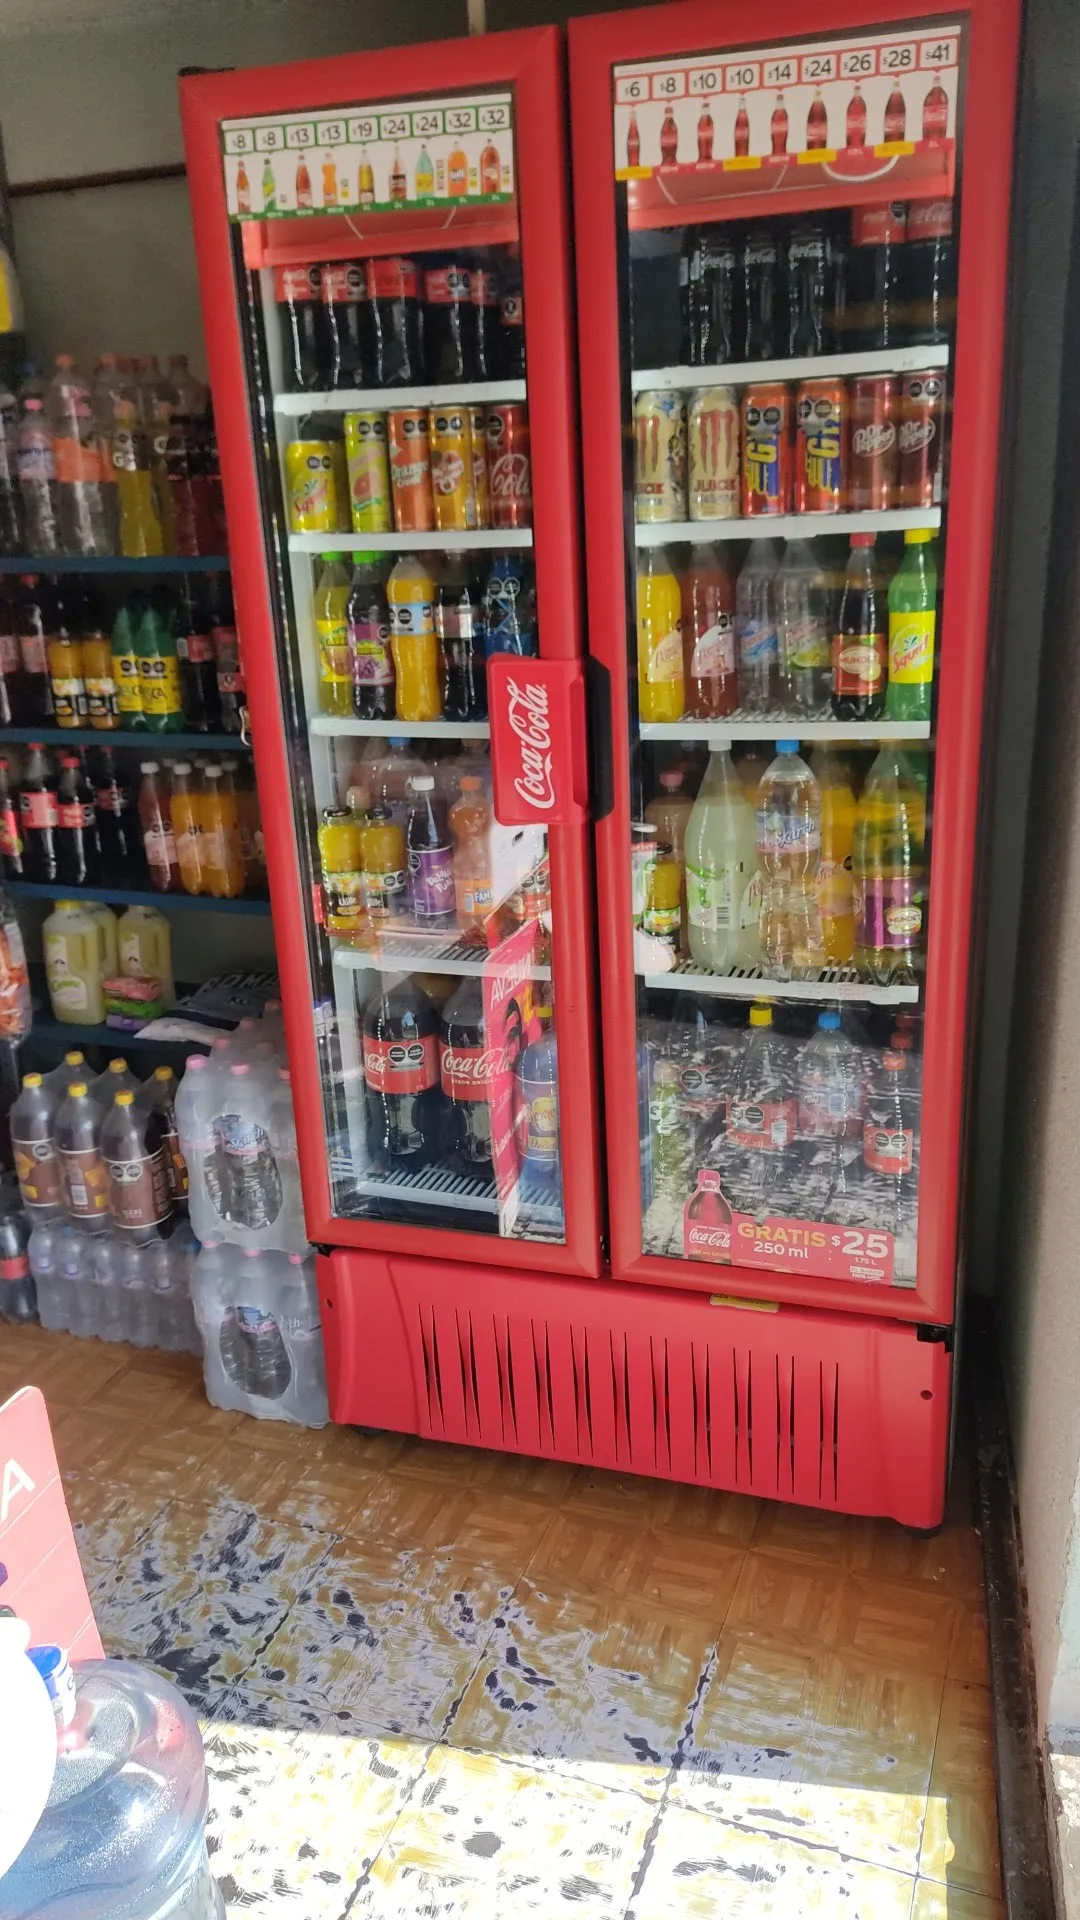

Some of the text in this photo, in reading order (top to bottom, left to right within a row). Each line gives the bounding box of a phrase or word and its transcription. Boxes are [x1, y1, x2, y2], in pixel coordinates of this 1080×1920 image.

[624, 44, 951, 97] $6 $8 $10 $10 $14 $24 $26 $28 $41
[353, 122, 373, 138] $19
[384, 119, 407, 135] $24
[416, 115, 439, 132] $24
[448, 112, 472, 129] $32
[482, 108, 506, 125] $32
[505, 676, 556, 809] Coca-Cola
[441, 1048, 510, 1079] Coca-Cola
[688, 1227, 731, 1248] Coca-Cola
[737, 1222, 827, 1248] GRATIS
[753, 1240, 810, 1260] 250 ml
[854, 1256, 878, 1266] 1.75 L
